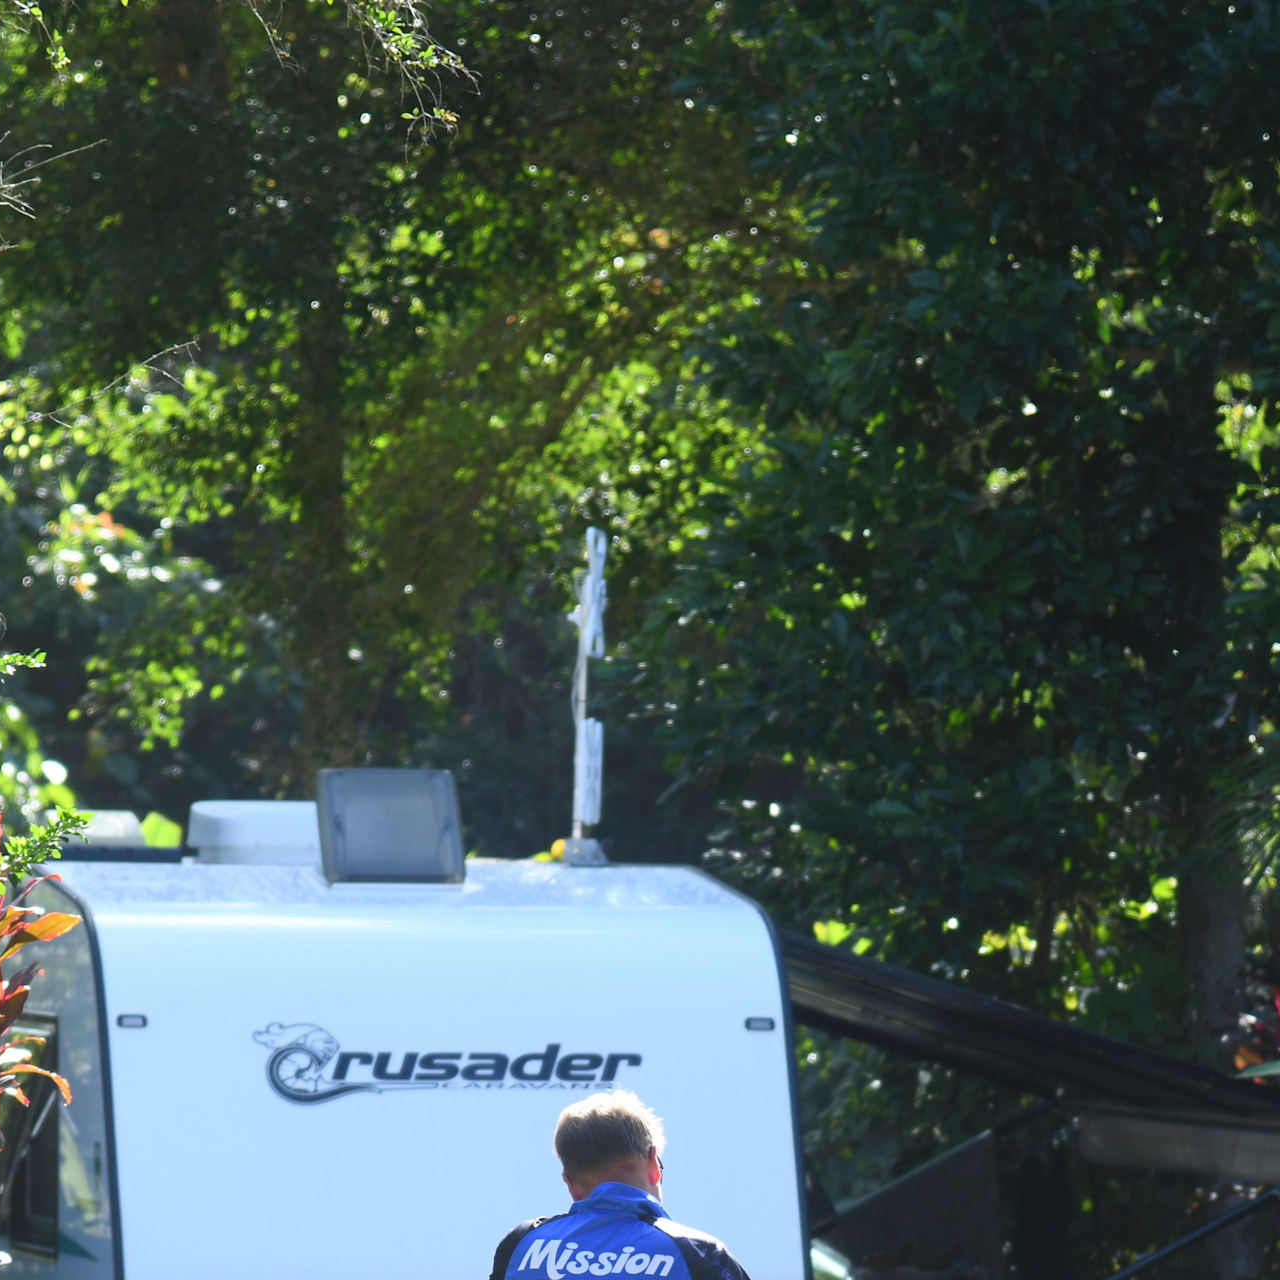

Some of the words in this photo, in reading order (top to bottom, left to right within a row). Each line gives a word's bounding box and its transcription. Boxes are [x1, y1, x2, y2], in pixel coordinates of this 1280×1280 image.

[266, 1043, 642, 1105] Crusader
[440, 1081, 613, 1090] CARAVANS
[518, 1239, 674, 1280] Mission
